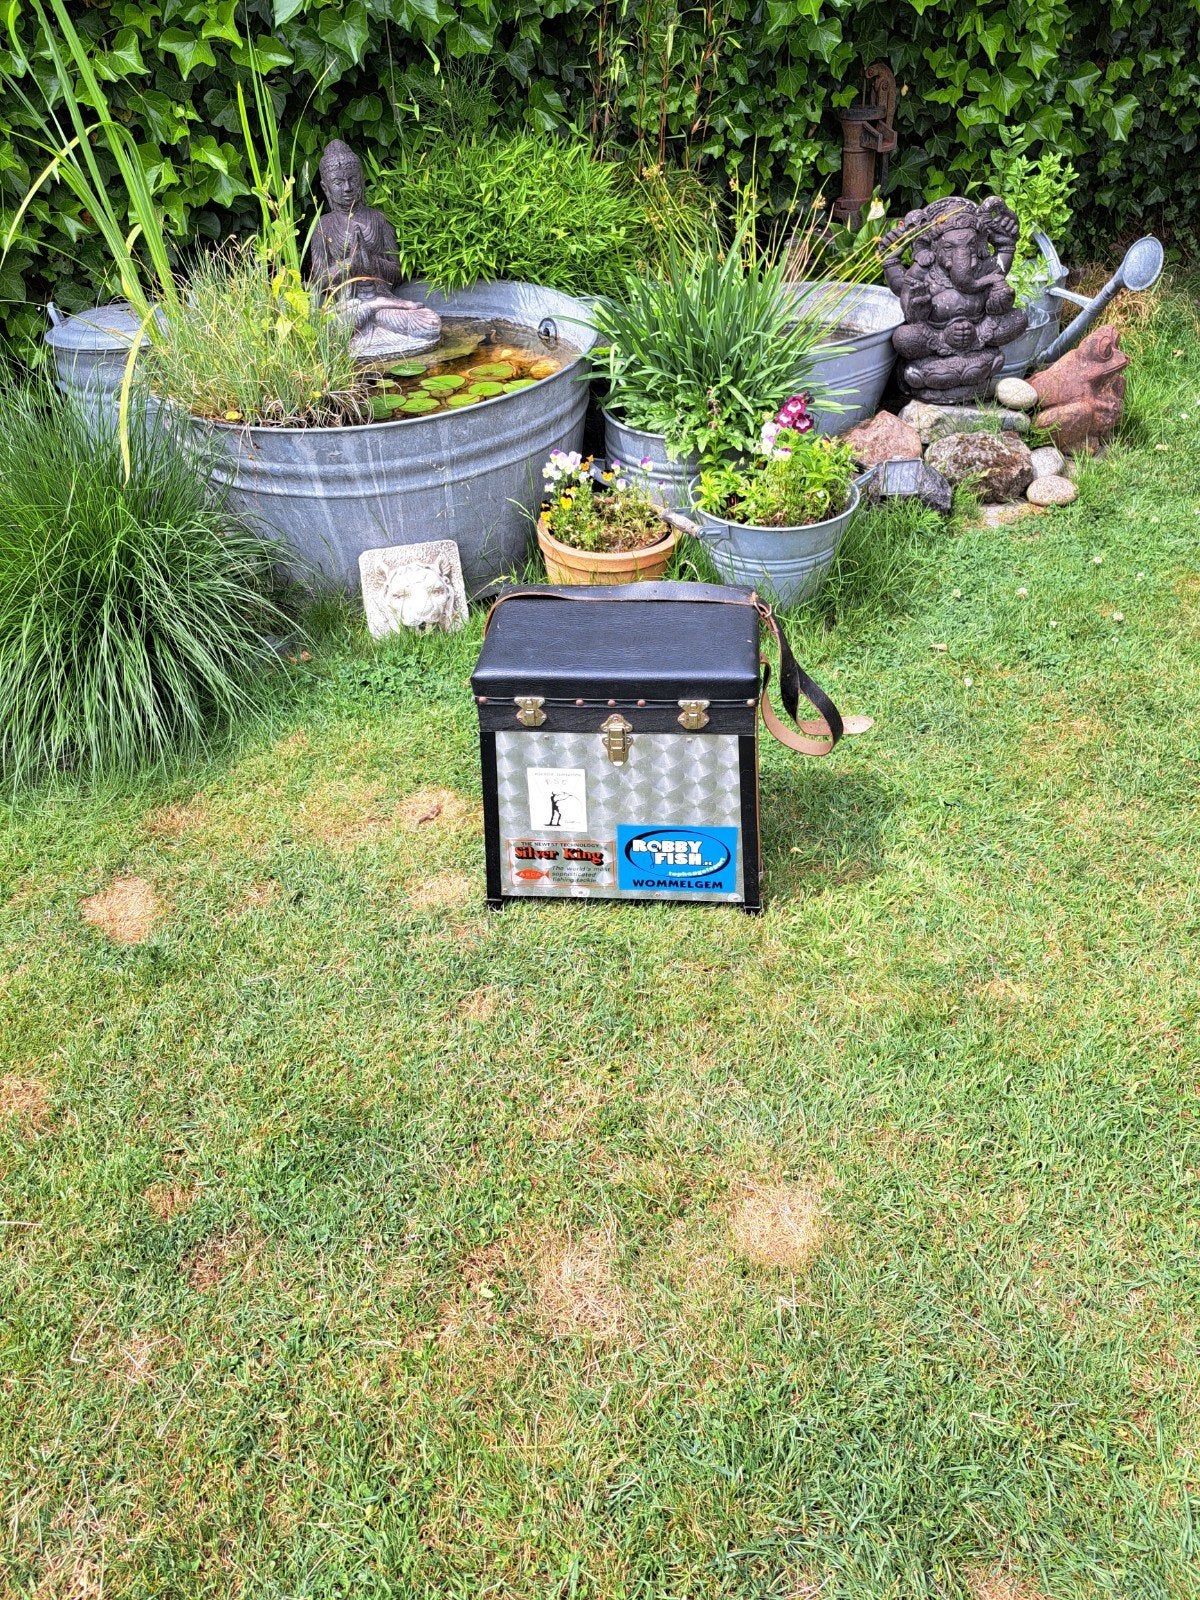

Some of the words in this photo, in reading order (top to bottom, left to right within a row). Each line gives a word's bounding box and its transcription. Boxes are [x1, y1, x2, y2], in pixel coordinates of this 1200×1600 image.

[632, 839, 703, 853] ROBBY
[514, 846, 560, 860] Silver
[563, 847, 604, 866] King
[632, 879, 723, 889] WOMMELGEM
